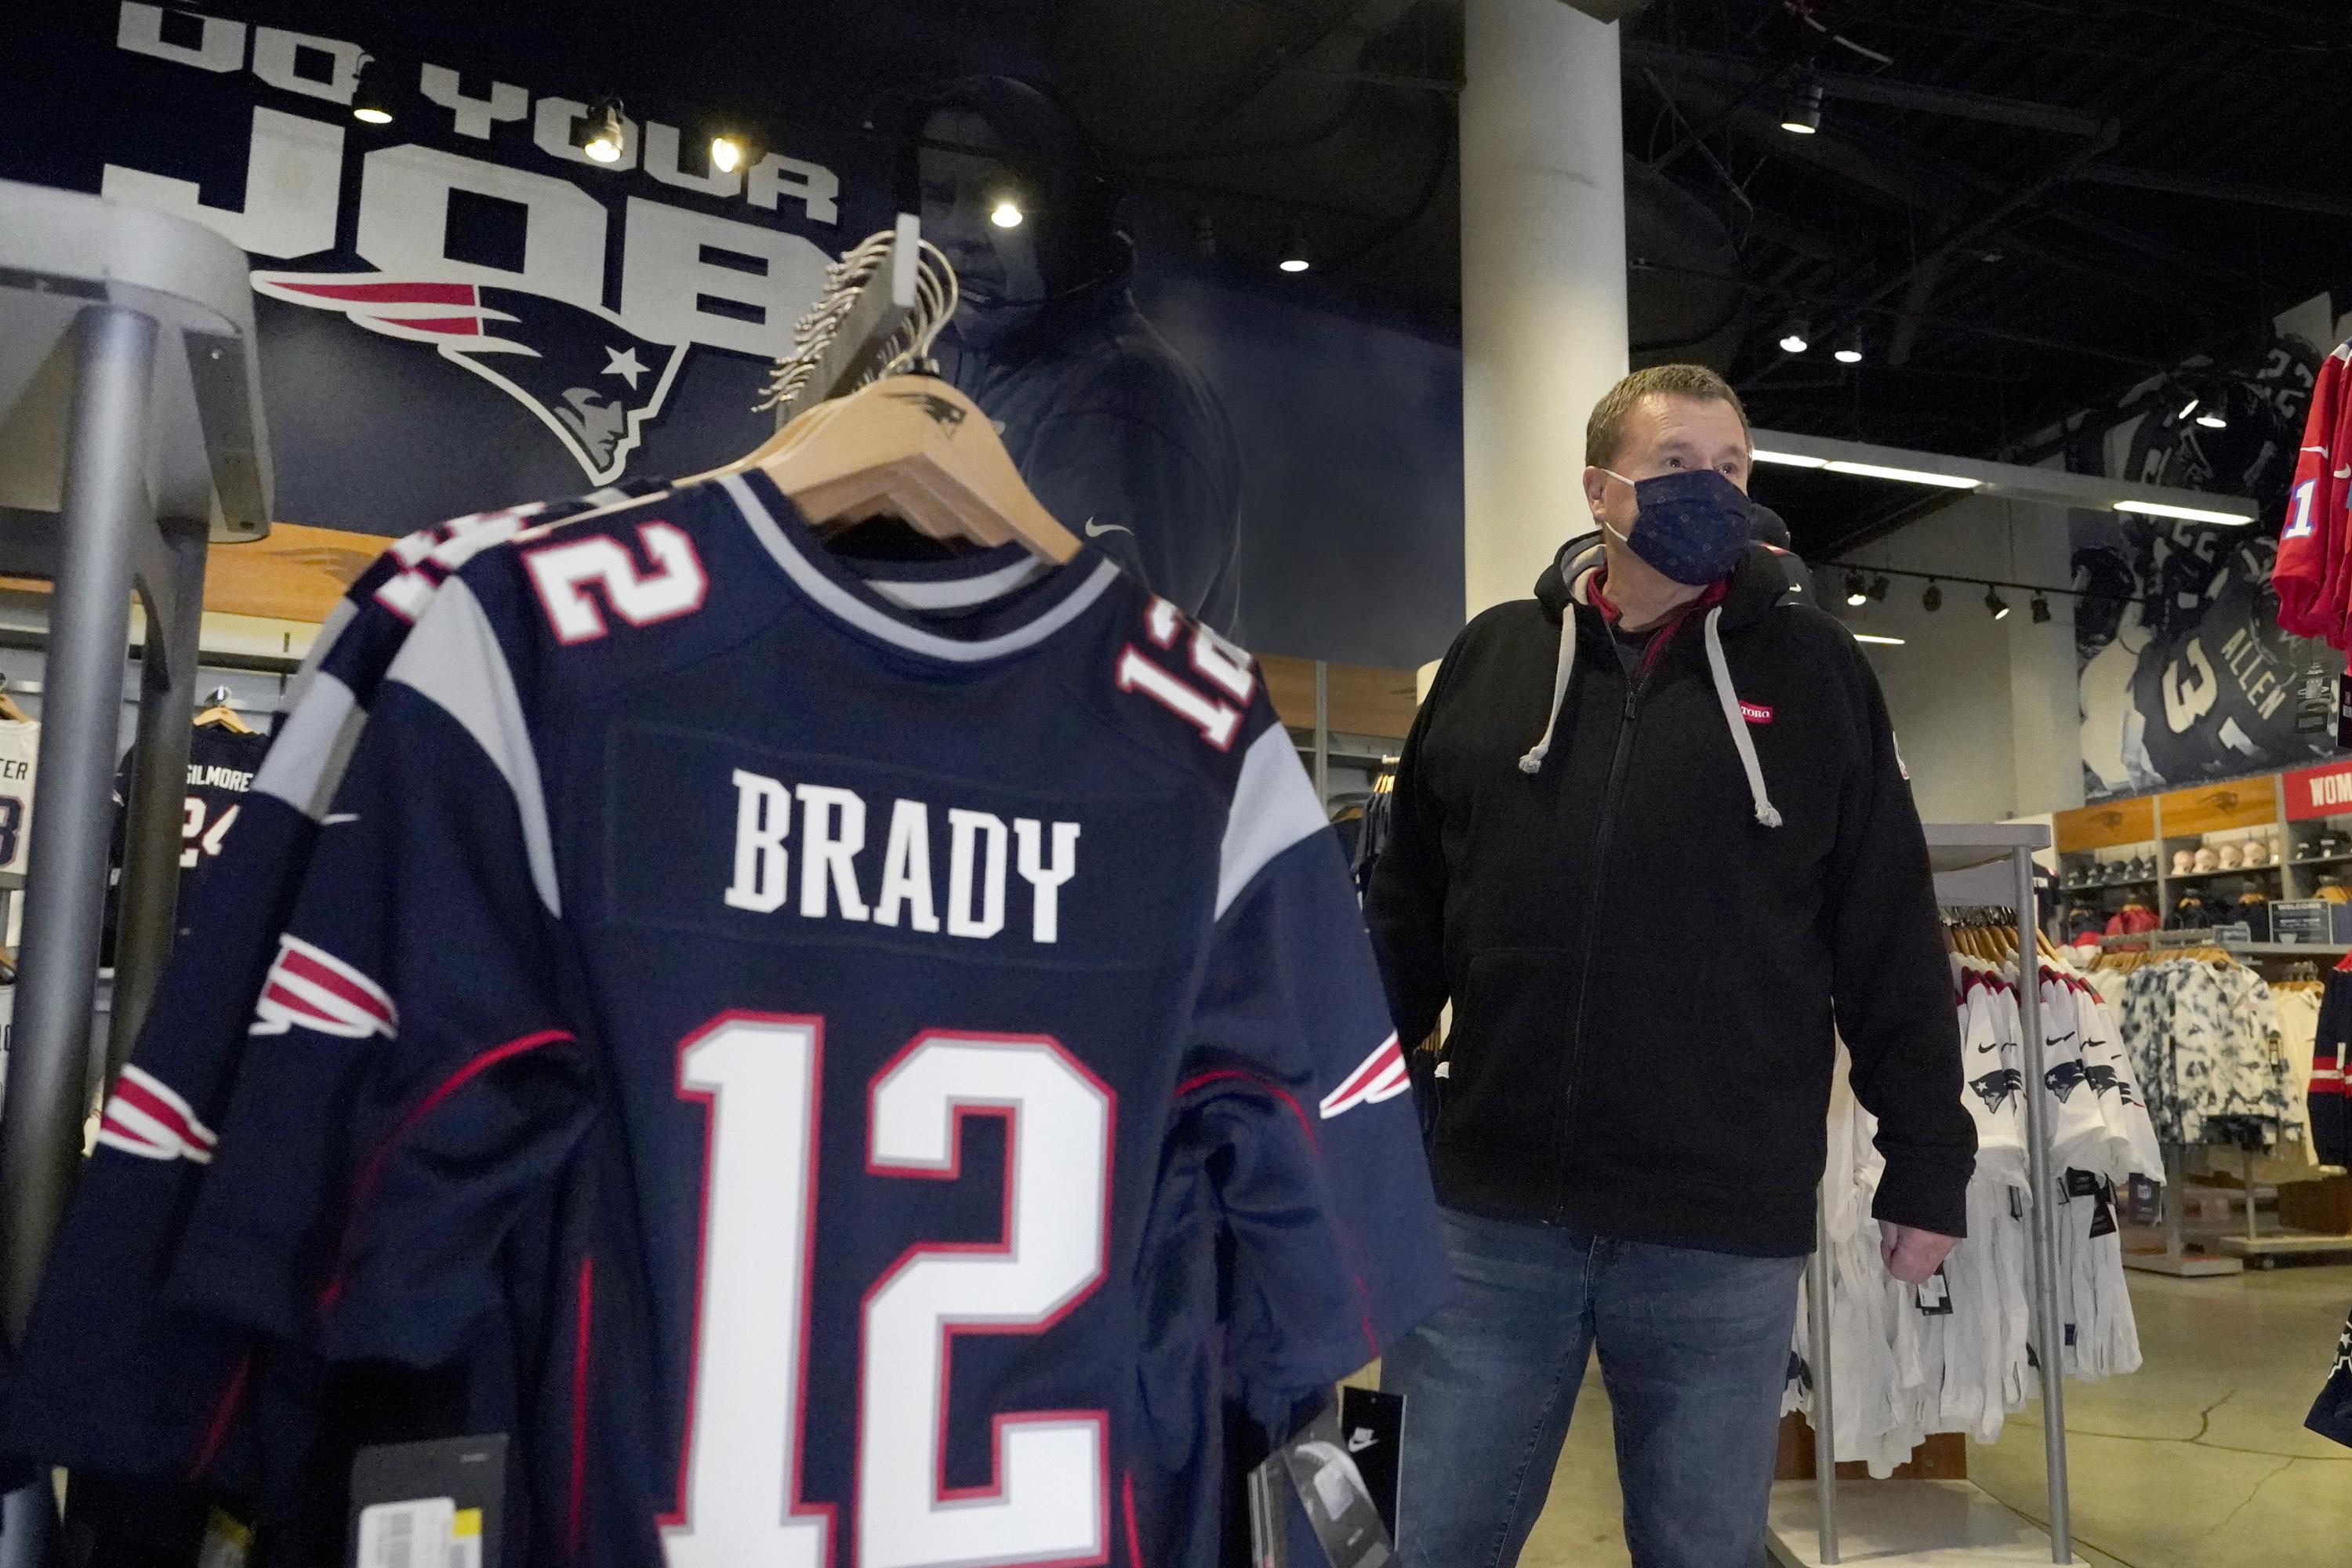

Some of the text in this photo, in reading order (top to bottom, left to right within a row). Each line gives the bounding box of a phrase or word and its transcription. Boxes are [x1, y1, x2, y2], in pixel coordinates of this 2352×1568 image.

[117, 0, 840, 226] DO YOUR
[101, 105, 837, 359] JOB
[2284, 479, 2317, 539] 1
[1740, 706, 1770, 718] TORO
[2220, 627, 2287, 720] ALLEN
[0, 758, 28, 780] ER
[725, 768, 1080, 943] BRADY
[657, 1009, 1116, 1568] 12
